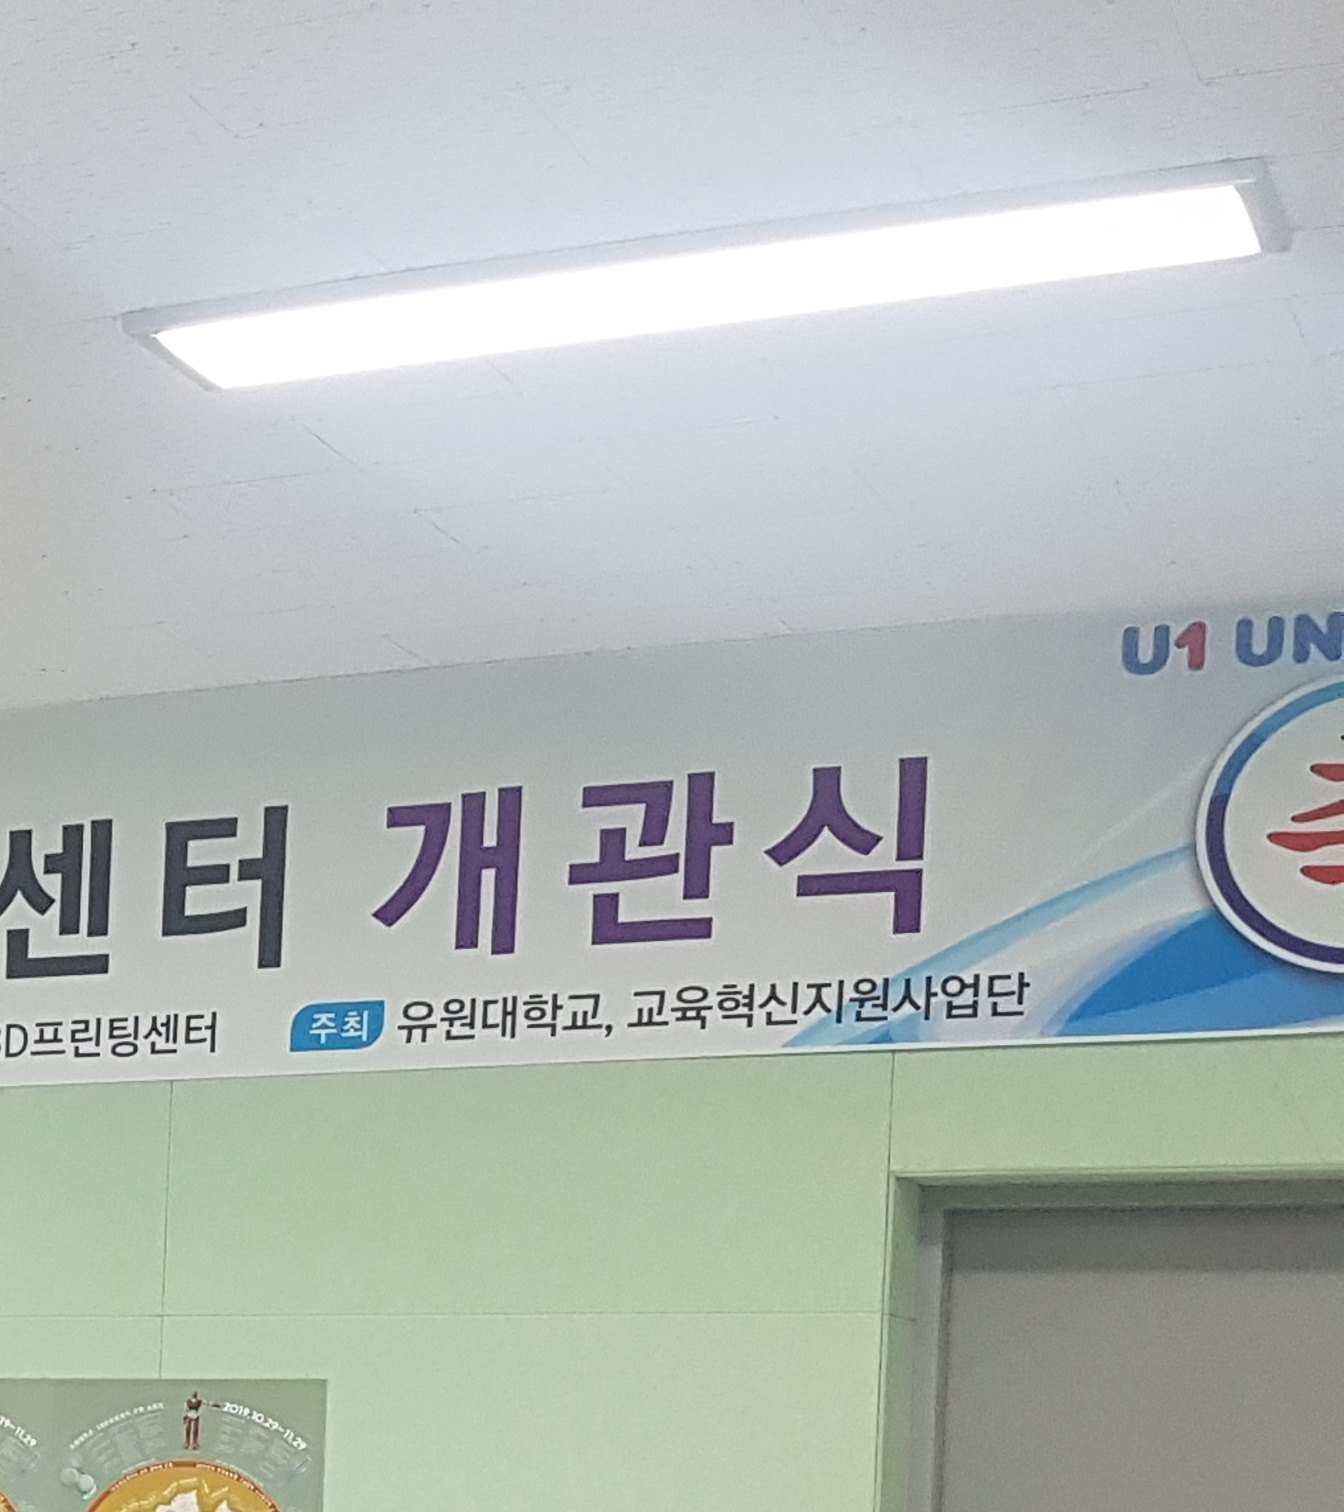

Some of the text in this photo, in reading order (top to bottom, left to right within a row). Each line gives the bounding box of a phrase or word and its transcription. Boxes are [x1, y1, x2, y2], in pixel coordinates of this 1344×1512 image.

[1121, 618, 1207, 675] U1
[371, 756, 929, 956] 개관식
[309, 971, 1030, 1045] 주최 유원대학교, 교육혁신지원사업단
